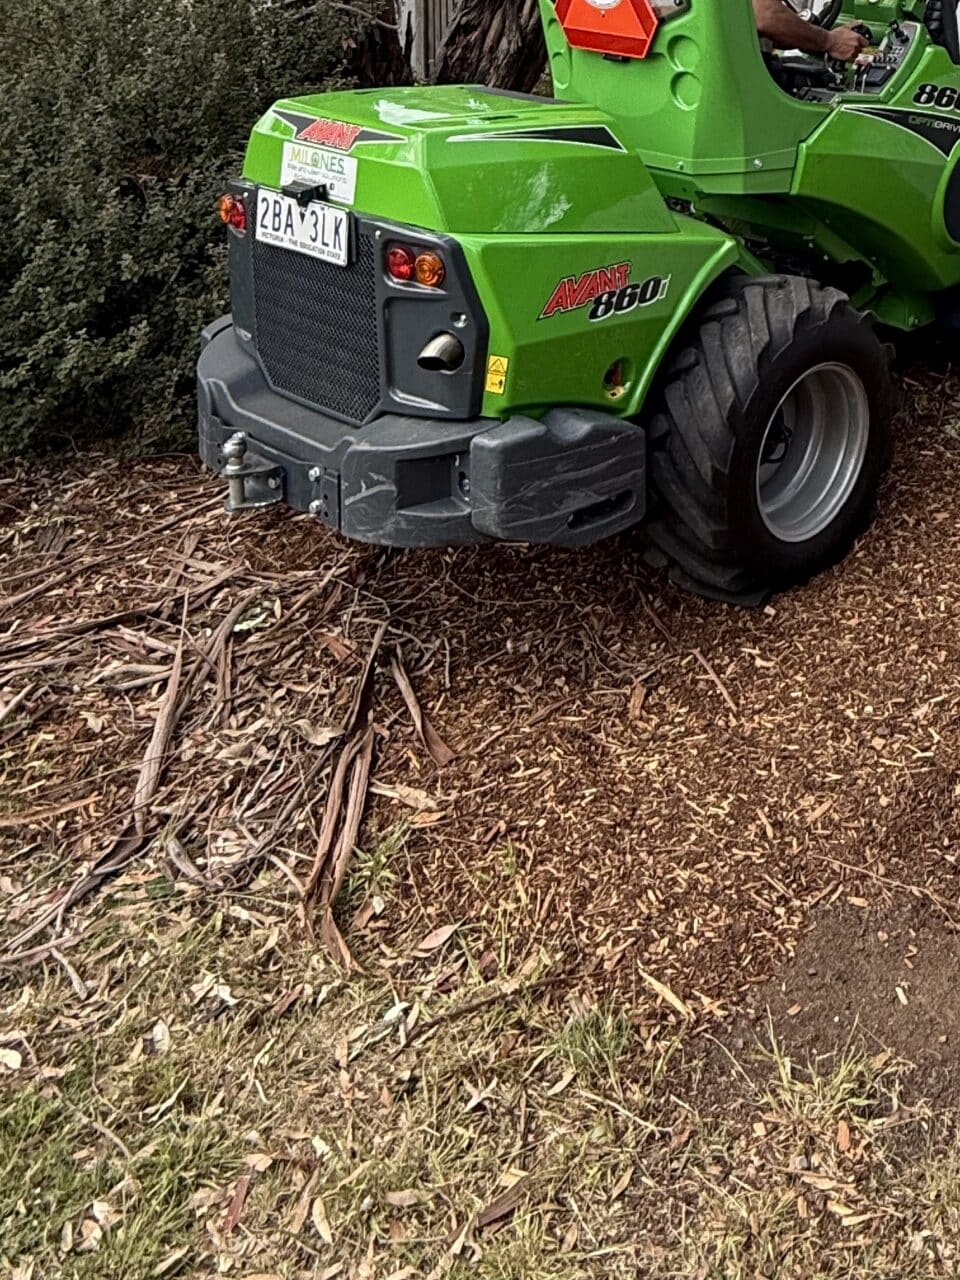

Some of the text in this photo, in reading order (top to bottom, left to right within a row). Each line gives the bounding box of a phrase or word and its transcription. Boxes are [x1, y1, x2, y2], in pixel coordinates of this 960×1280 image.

[296, 118, 361, 151] AVANT
[291, 146, 346, 175] MILONES
[260, 197, 343, 251] 2BA 3LK
[537, 261, 630, 319] AVANT
